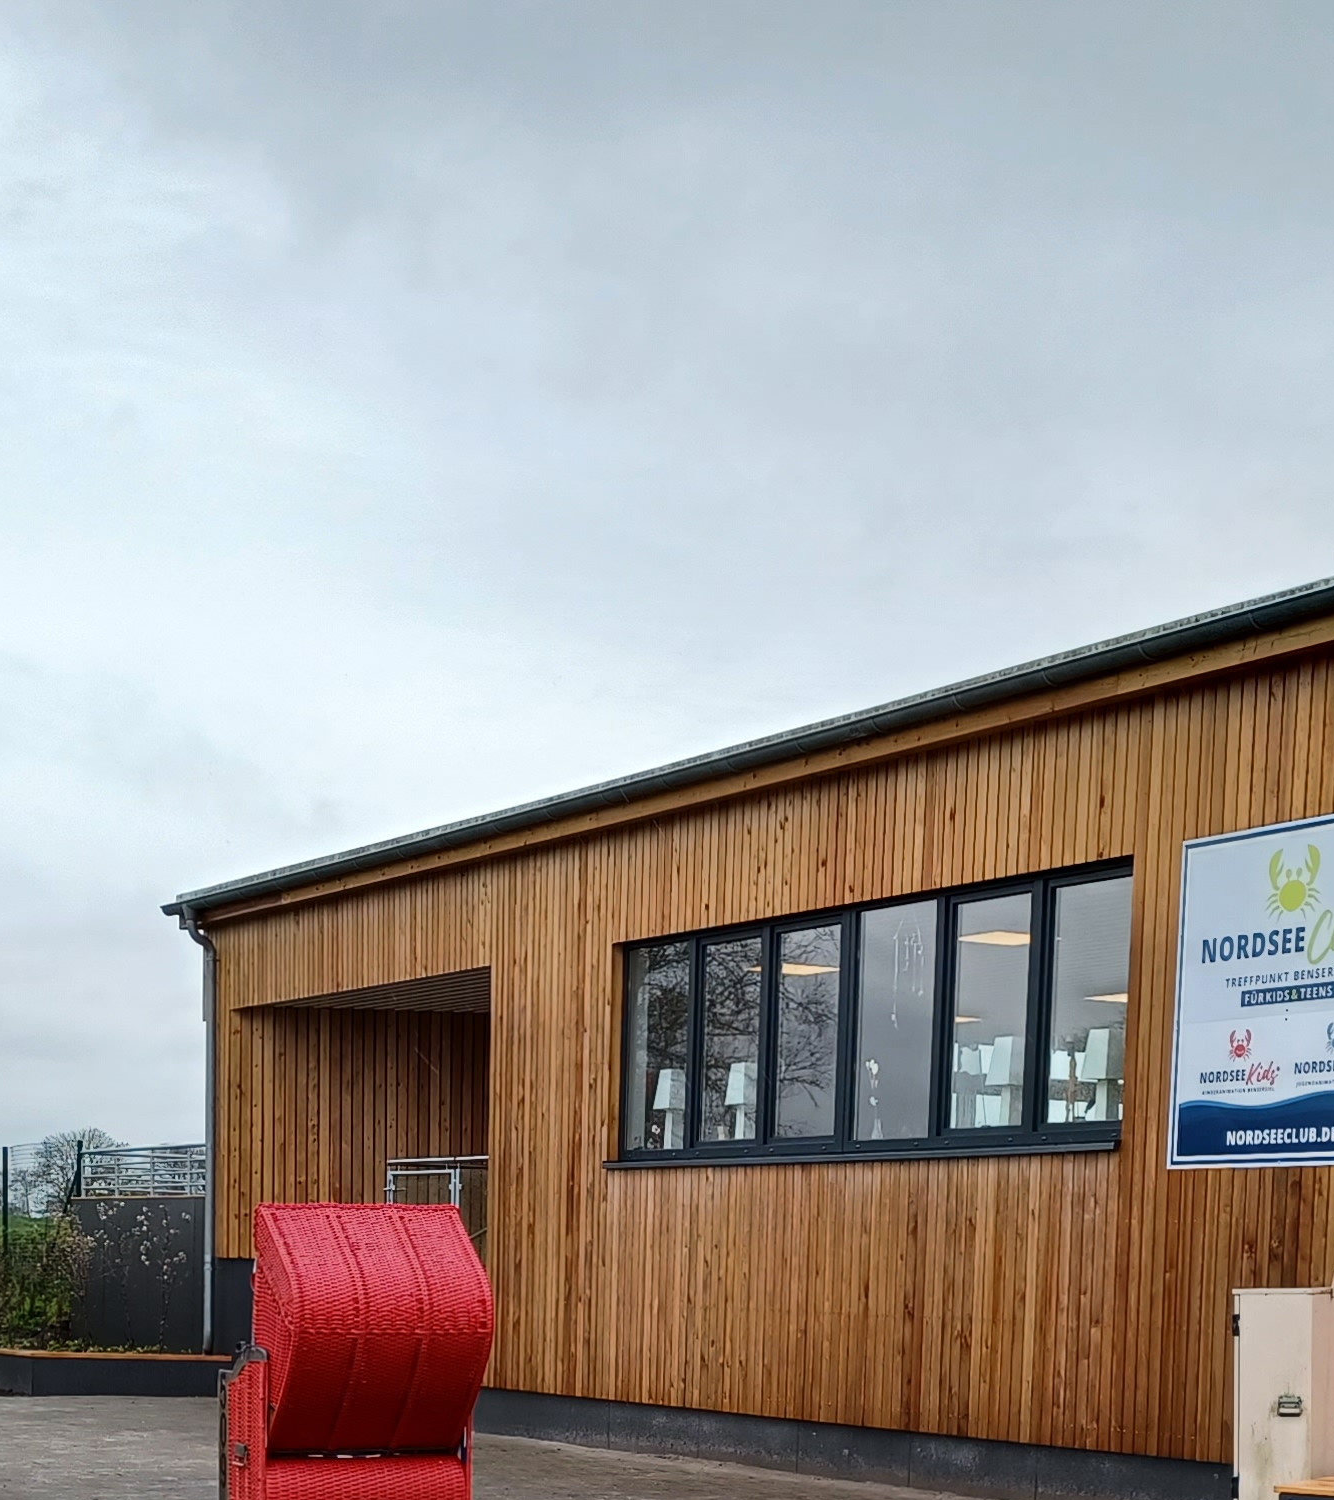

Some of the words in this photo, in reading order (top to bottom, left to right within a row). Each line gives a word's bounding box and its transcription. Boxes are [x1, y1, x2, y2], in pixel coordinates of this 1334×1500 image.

[1201, 926, 1306, 964] NORDSEE
[1225, 971, 1290, 989] TREFFPUNKT
[1300, 985, 1333, 999] TEENS
[1199, 1069, 1246, 1084] NORDSEE
[1245, 1060, 1279, 1086] Kids
